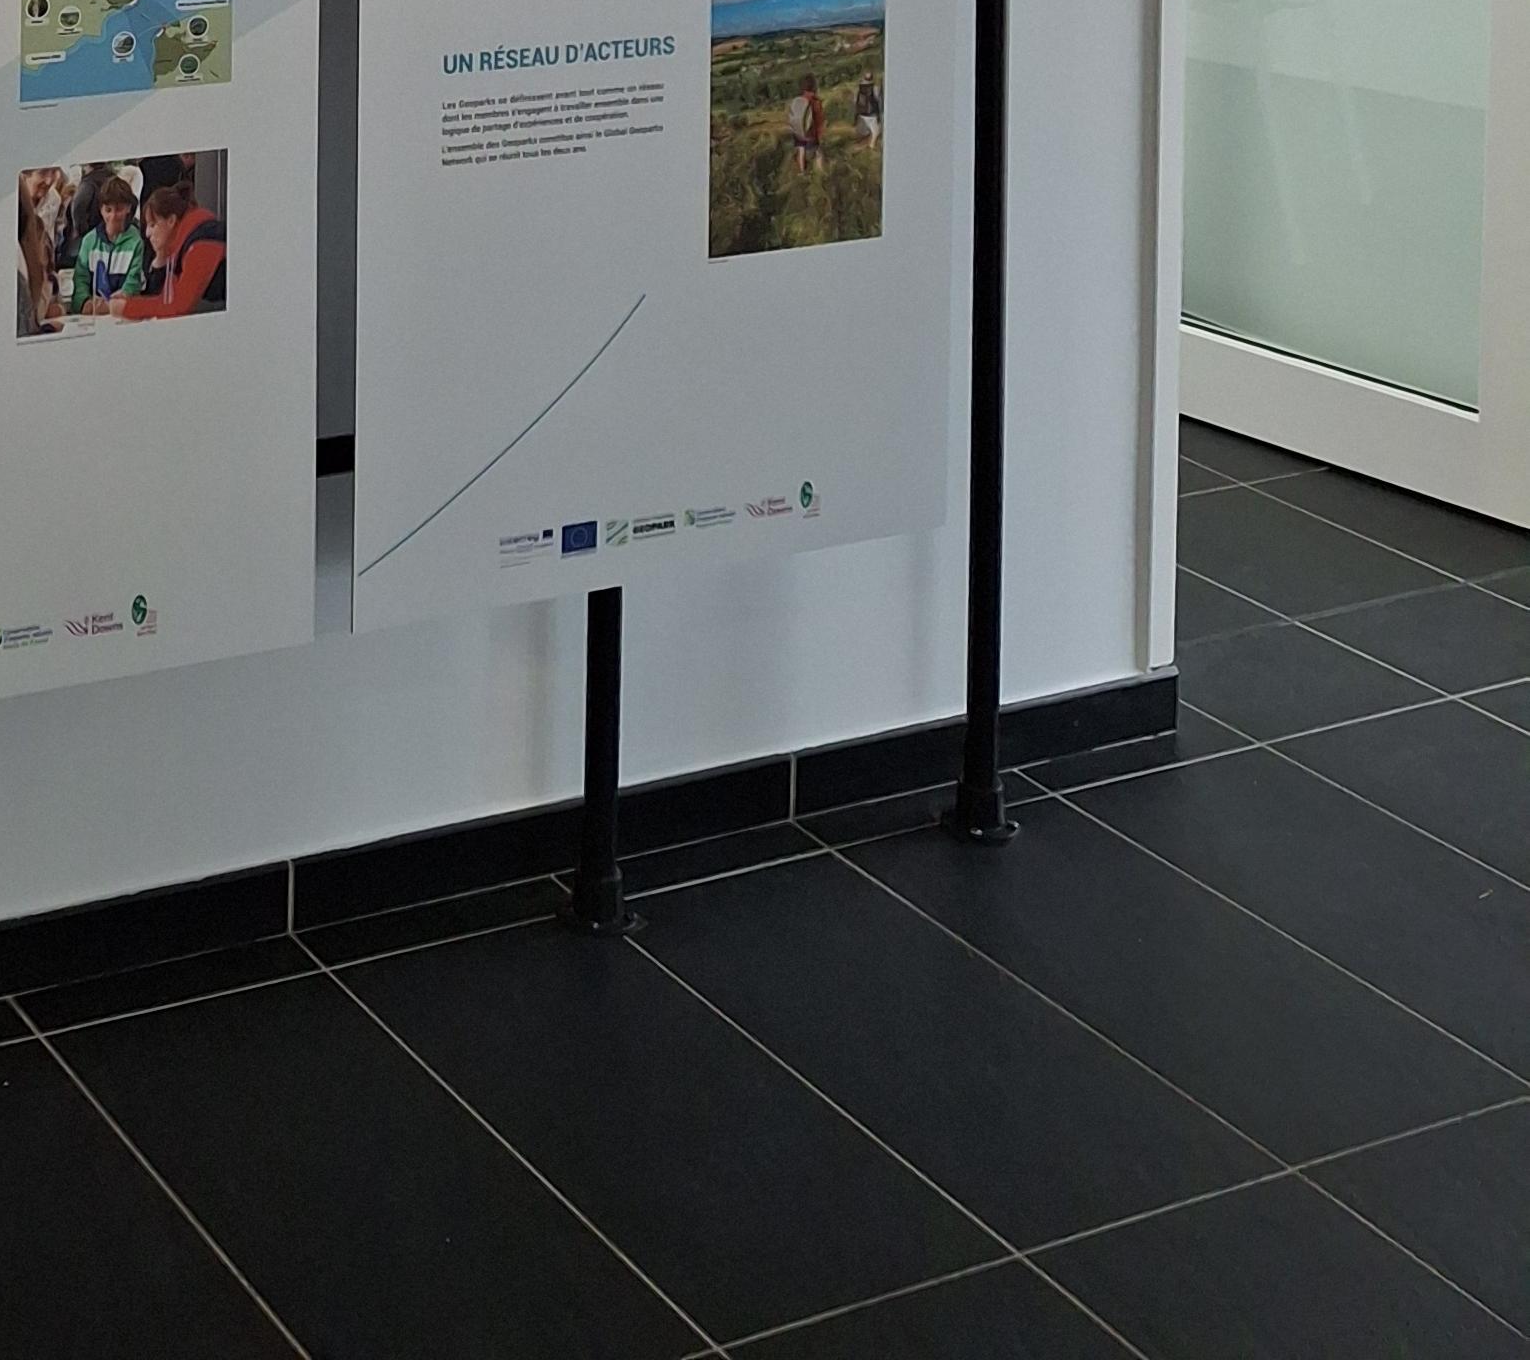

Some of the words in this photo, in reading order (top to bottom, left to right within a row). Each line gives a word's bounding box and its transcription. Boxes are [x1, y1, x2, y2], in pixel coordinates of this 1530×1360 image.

[443, 52, 474, 75] UN
[479, 44, 560, 72] RÉSEAU
[565, 35, 675, 64] D'ACTEURS
